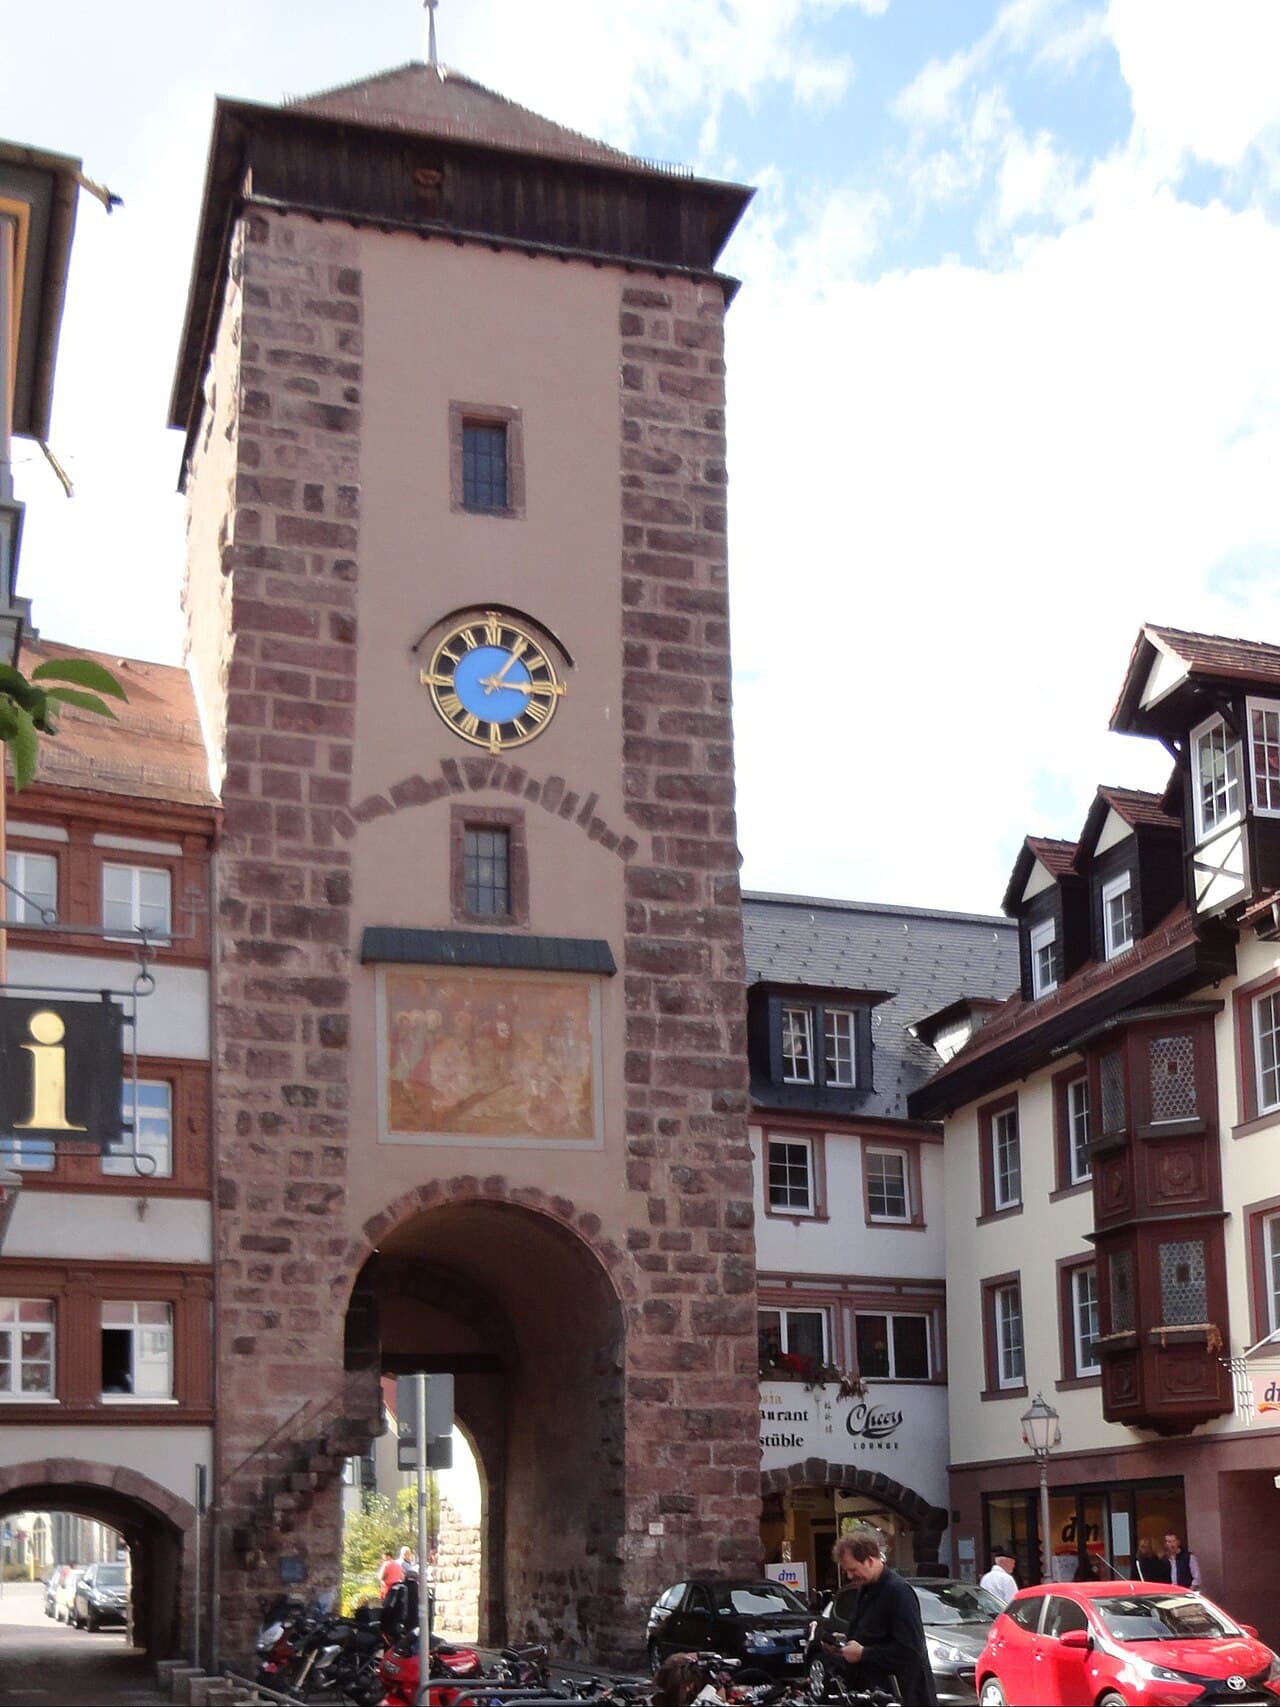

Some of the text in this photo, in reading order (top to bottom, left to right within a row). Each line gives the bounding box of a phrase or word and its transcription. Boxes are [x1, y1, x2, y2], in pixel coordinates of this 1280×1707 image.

[442, 646, 460, 665] X
[13, 1011, 88, 1131] i
[853, 1442, 899, 1450] LOUNGE
[778, 1570, 796, 1581] dm
